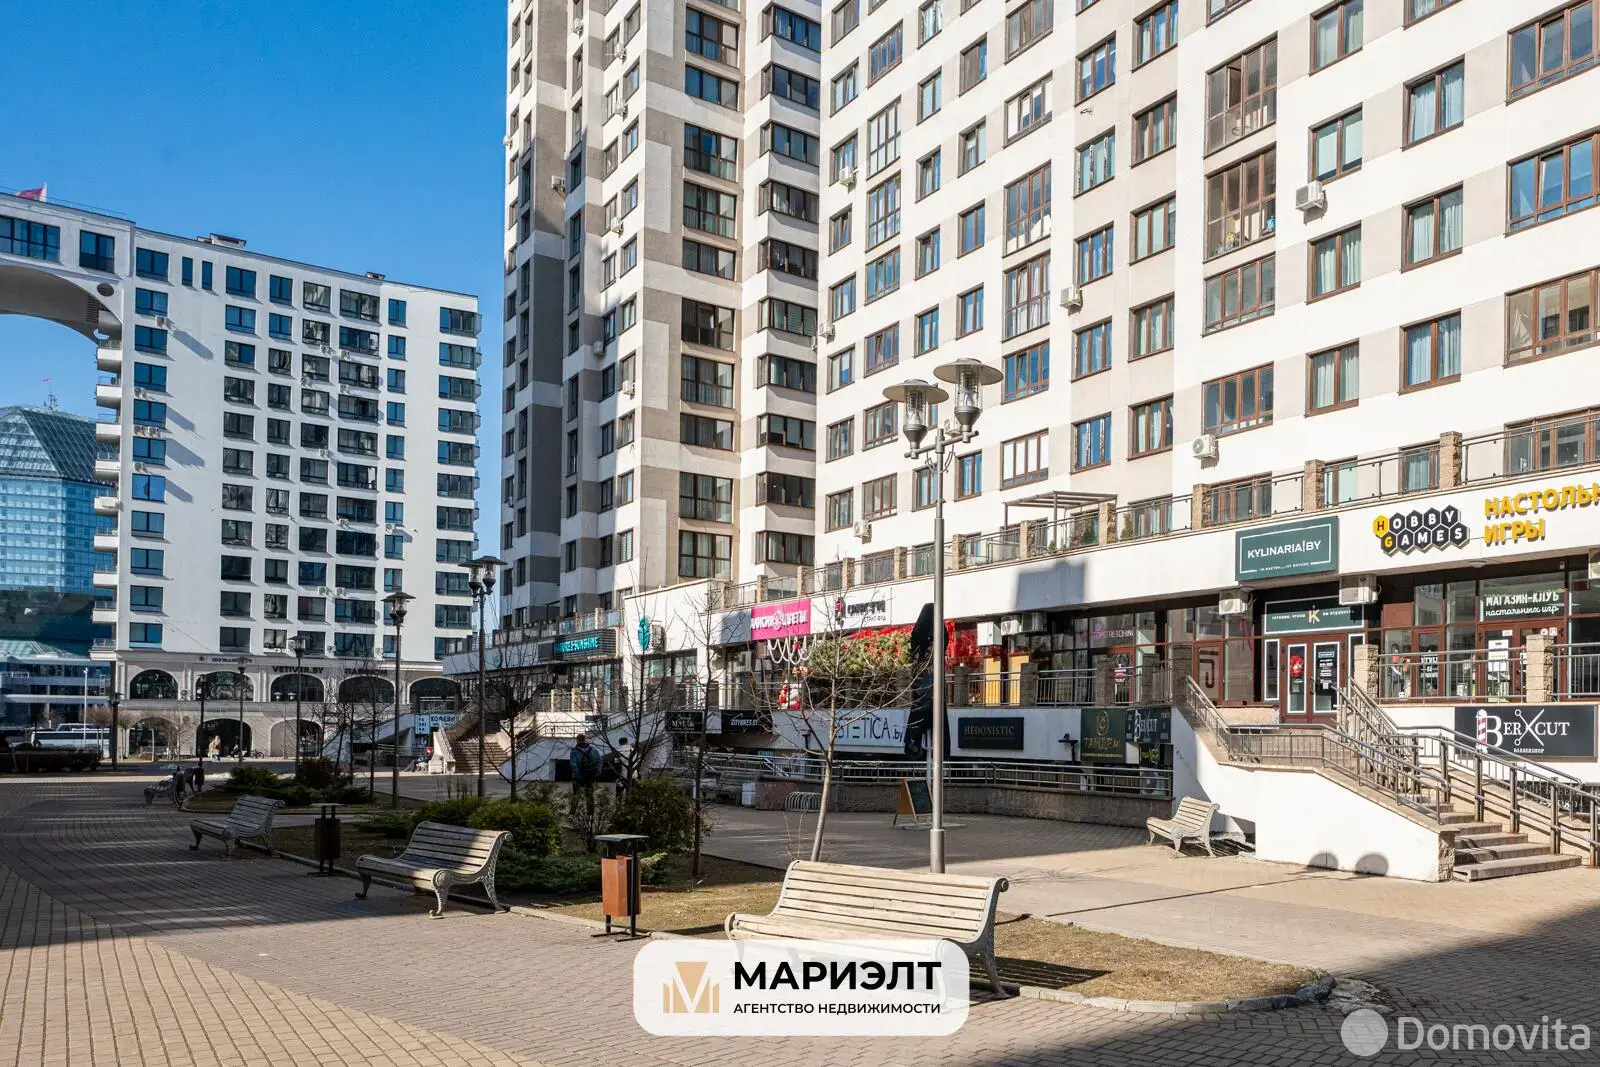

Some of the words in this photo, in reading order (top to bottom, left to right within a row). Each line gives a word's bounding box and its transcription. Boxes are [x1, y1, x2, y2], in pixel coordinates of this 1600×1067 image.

[1377, 510, 1455, 531] HOBBY
[1384, 527, 1463, 548] GAMES
[1484, 518, 1544, 545] ИГРЫ
